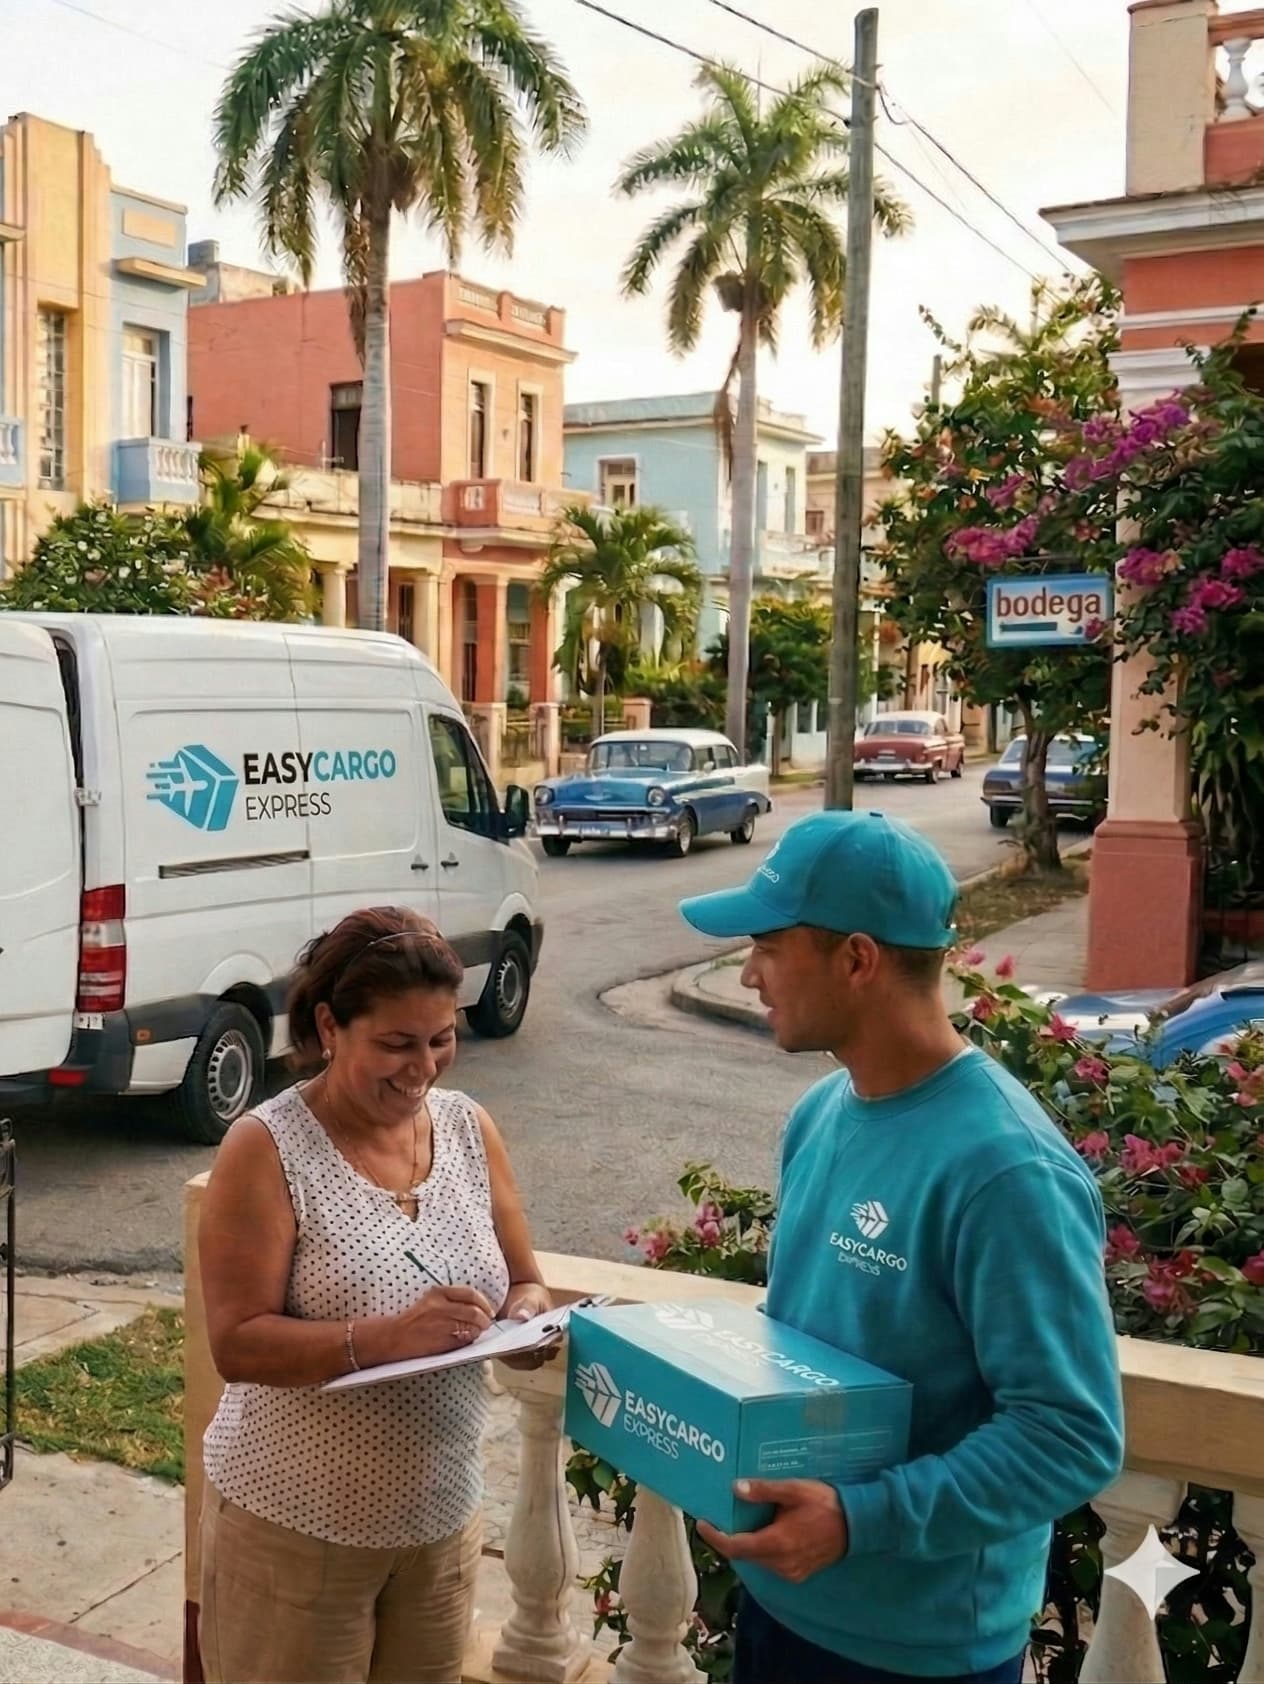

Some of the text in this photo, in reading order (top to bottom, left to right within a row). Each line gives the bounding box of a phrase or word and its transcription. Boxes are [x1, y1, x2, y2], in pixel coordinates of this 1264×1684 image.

[997, 586, 1100, 622] bodega
[243, 750, 397, 785] EASYCARGO
[245, 791, 332, 820] EXPRESS
[830, 1231, 907, 1272] EASYCARGO
[623, 1413, 679, 1460] EXPRESS
[625, 1389, 725, 1463] EASYCARGO
